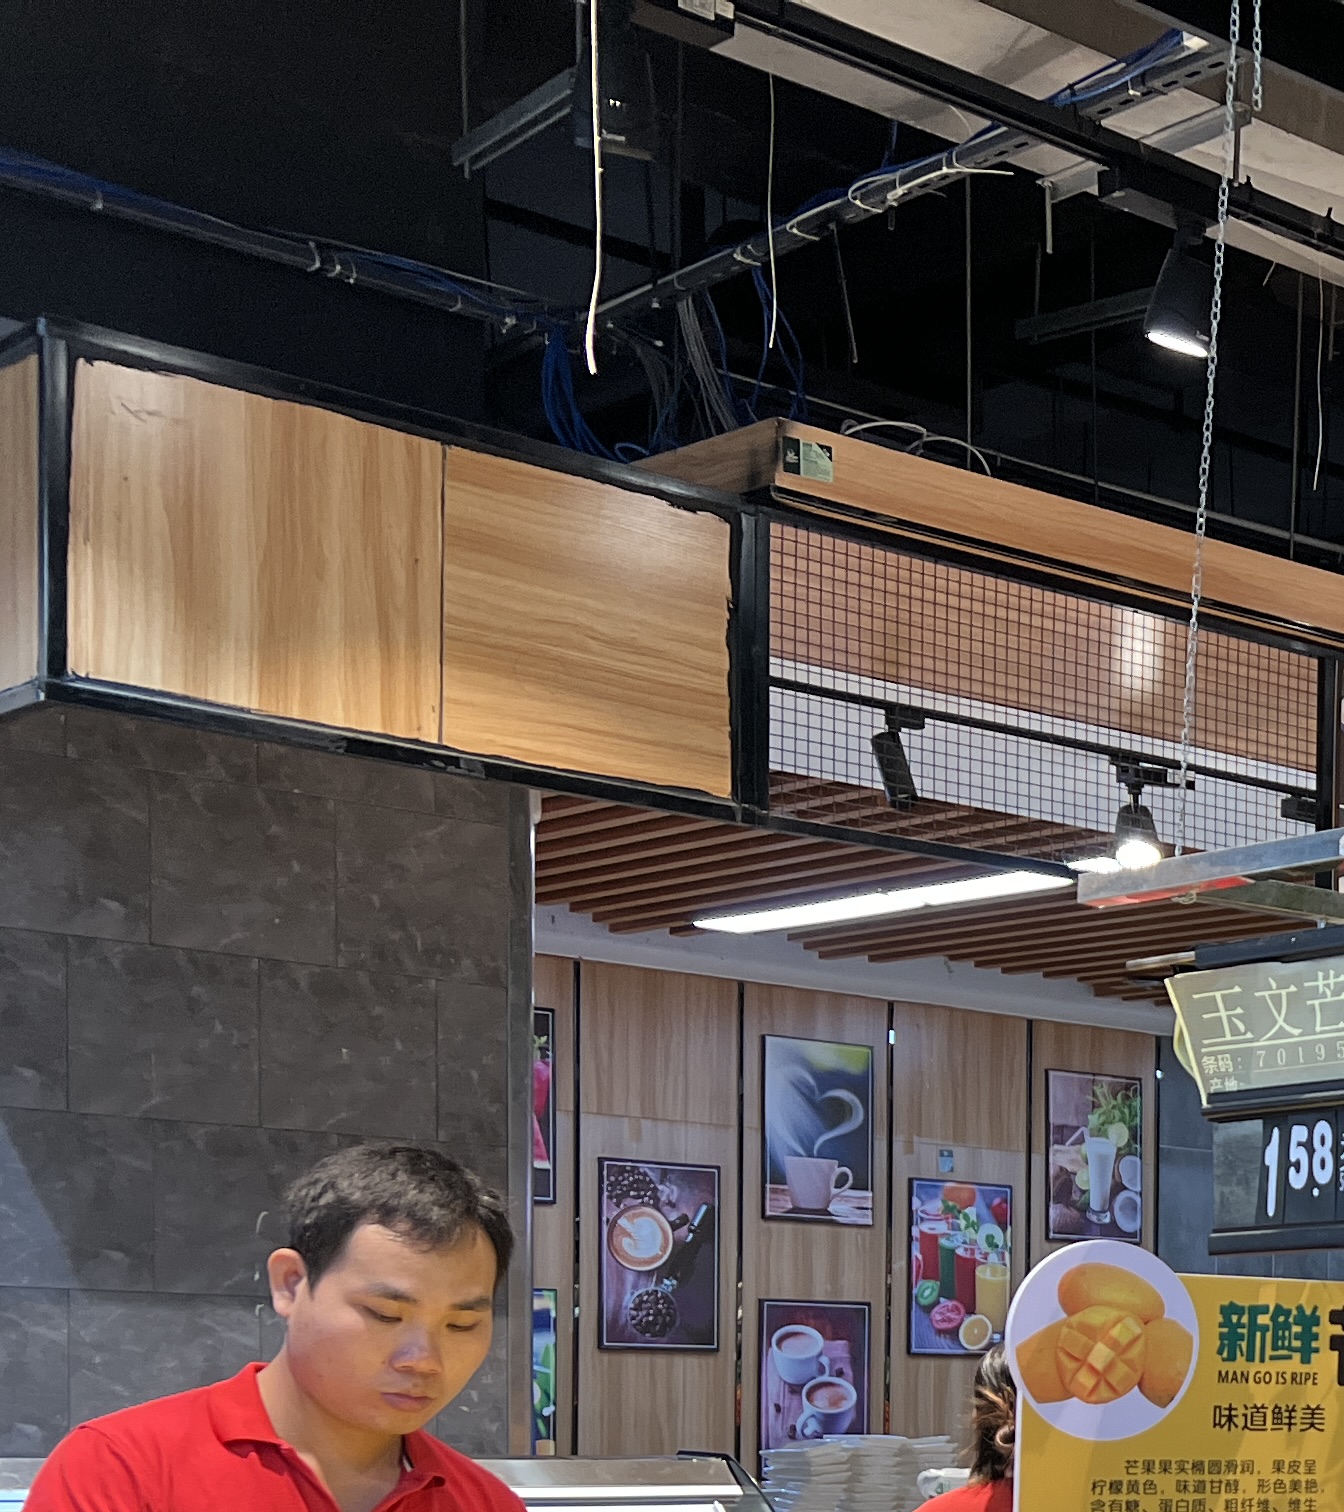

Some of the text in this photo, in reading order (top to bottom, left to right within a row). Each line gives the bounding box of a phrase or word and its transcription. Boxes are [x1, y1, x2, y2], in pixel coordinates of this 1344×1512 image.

[1276, 1371, 1287, 1385] IS
[1290, 1371, 1319, 1386] RIPE
[1212, 1402, 1326, 1433] 味道鲜美
